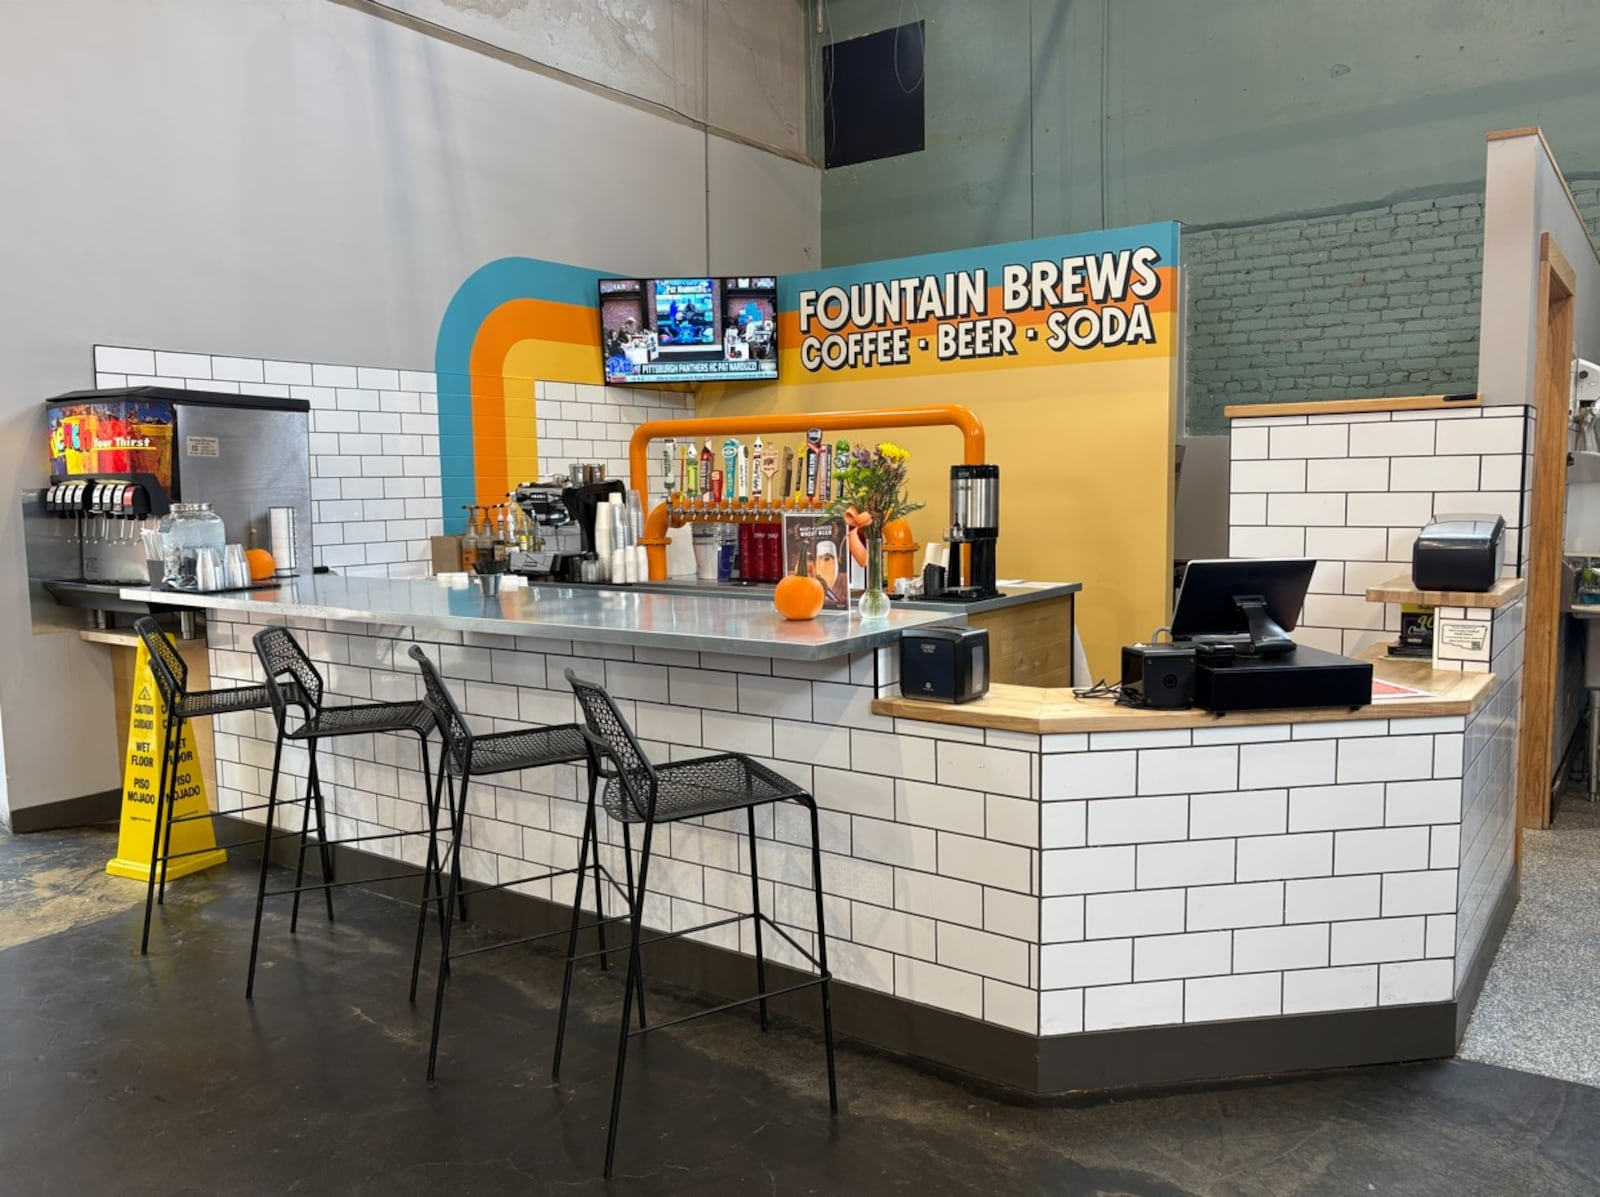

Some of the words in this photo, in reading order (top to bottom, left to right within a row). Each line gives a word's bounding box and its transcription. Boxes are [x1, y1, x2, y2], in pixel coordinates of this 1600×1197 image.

[799, 268, 988, 333] FOUNTAIN
[1003, 245, 1162, 312] BREWS
[800, 327, 910, 372] COFFEE
[937, 317, 1018, 360] BEER
[1046, 302, 1157, 351] SODA
[641, 364, 678, 374] PITTSBURGH
[678, 363, 708, 373] PANTHERS
[114, 436, 151, 447] Thirst
[135, 704, 154, 714] CAUTION
[134, 718, 153, 730] CUIDADO
[135, 741, 151, 752] WET
[131, 755, 154, 768] FLOOR
[133, 777, 150, 790] PISO
[176, 773, 191, 786] ISO
[128, 790, 155, 804] MOJADO
